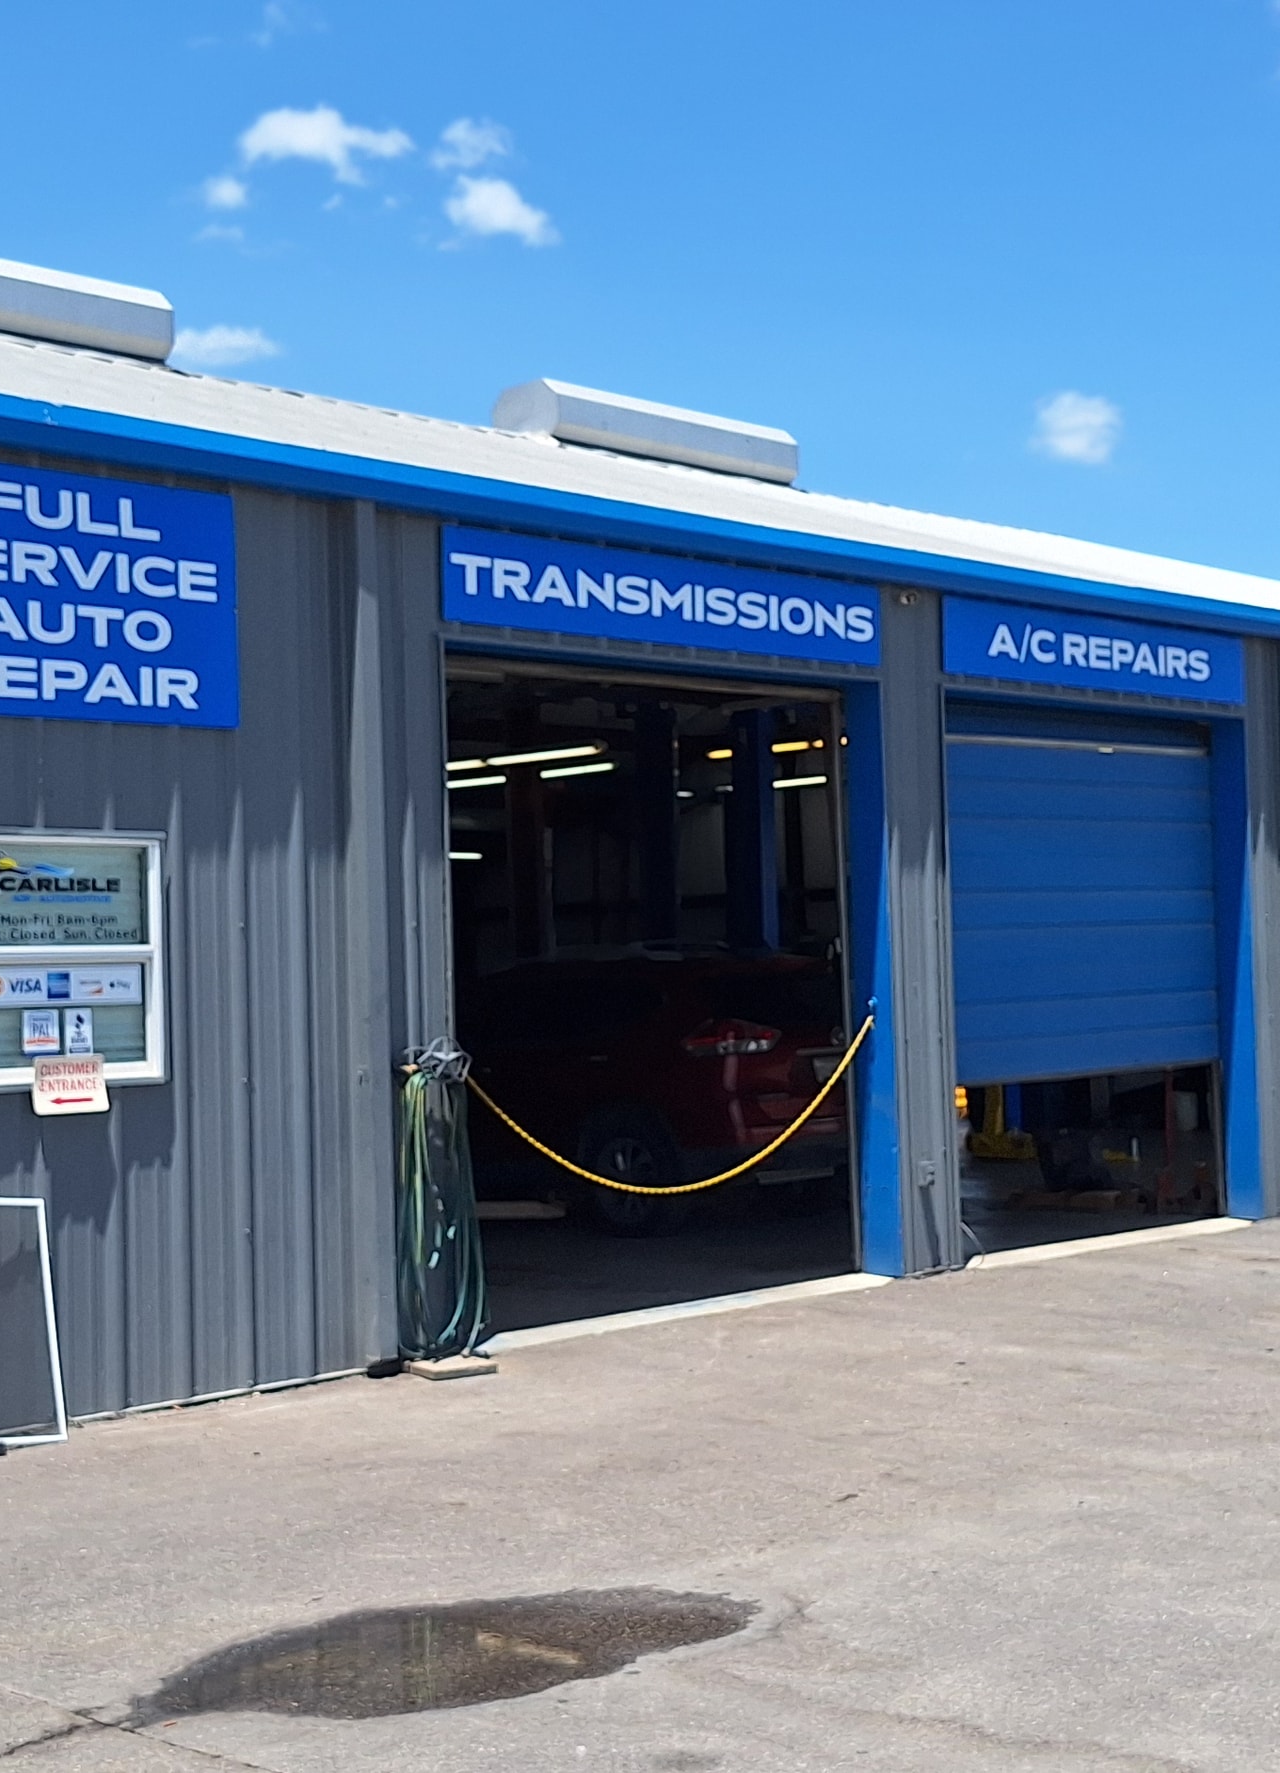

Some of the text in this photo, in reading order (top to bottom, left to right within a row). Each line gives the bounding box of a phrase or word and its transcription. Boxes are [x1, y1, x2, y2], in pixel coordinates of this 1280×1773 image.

[449, 552, 876, 643] TRANSMISSIONS
[987, 623, 1211, 682] A/C REPAIRS
[0, 877, 120, 892] CARLISLE
[10, 928, 56, 940] Closed
[94, 928, 139, 940] Closed
[10, 978, 42, 994] VISA
[40, 1061, 99, 1076] CUSTOMER
